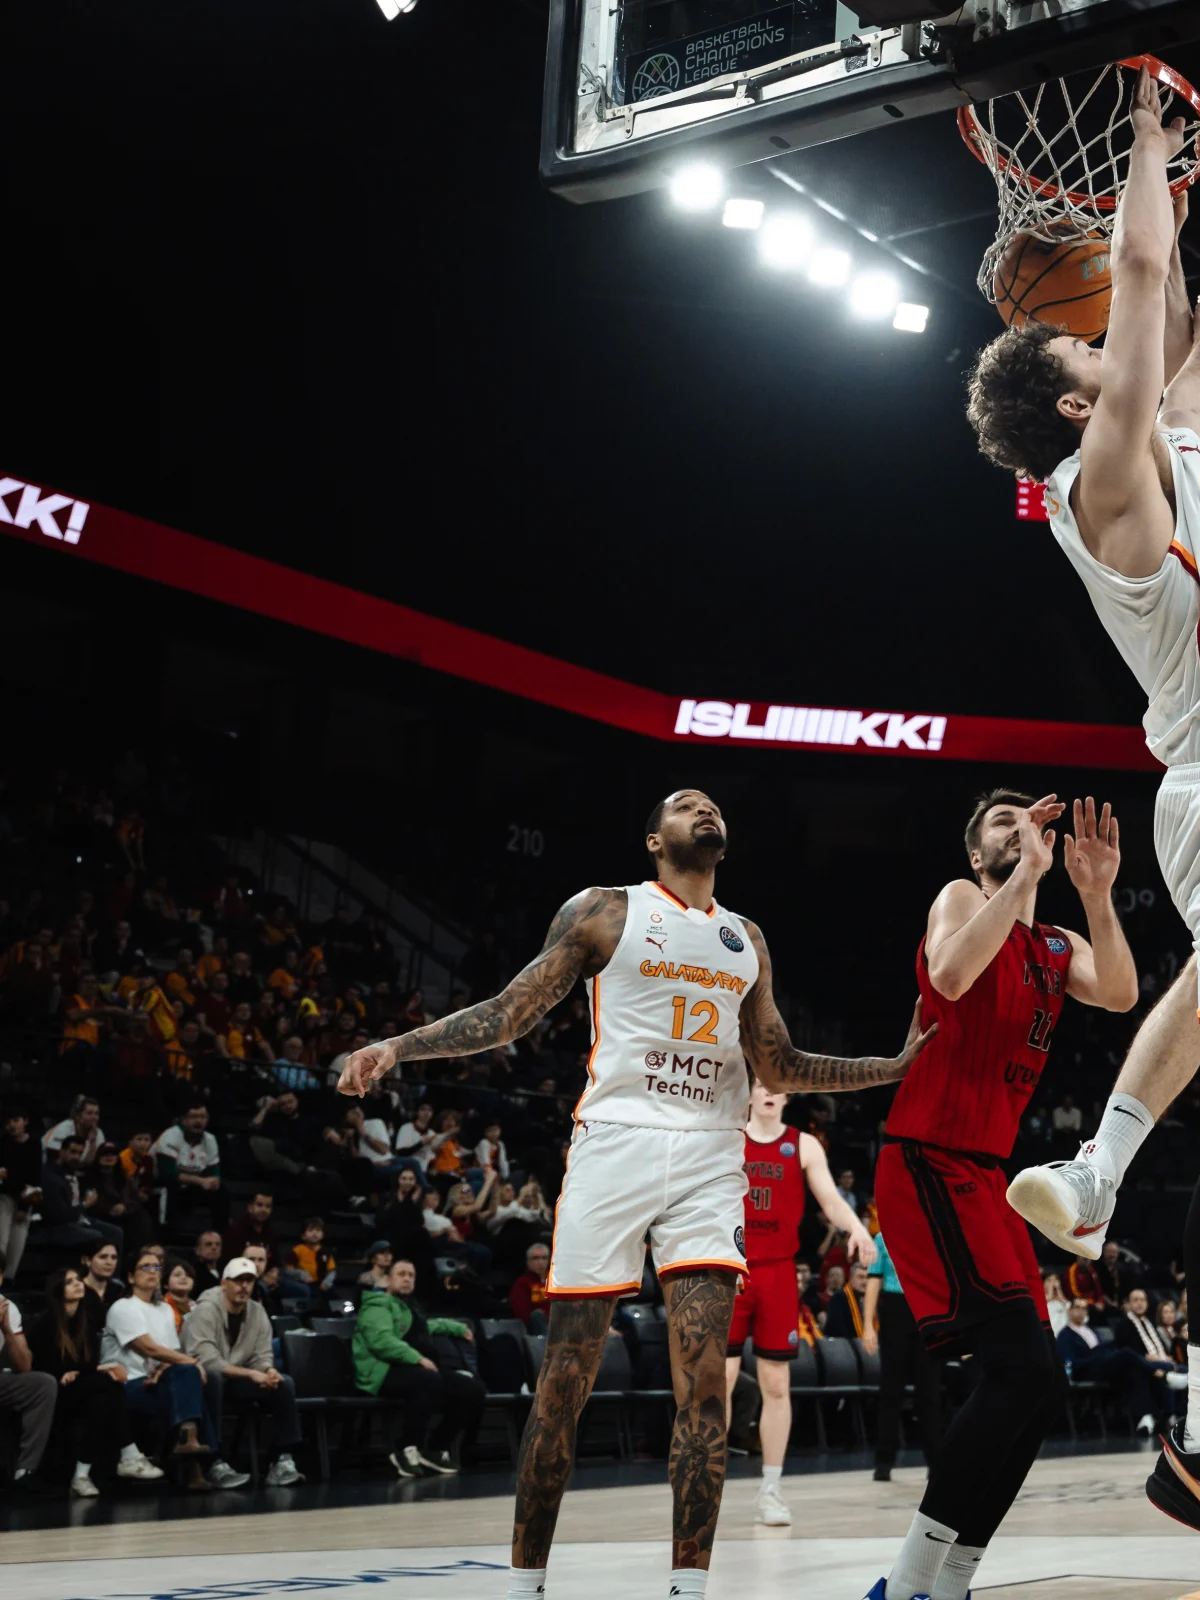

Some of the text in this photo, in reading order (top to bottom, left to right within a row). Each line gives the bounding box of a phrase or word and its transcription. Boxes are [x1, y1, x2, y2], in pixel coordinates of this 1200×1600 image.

[685, 28, 785, 70] CHAMPIONS
[686, 19, 774, 55] BASKETBALL
[684, 58, 738, 84] LEAGUE
[506, 823, 545, 858] 210
[640, 959, 748, 995] GALATASARAY
[671, 995, 719, 1045] 12
[671, 1053, 724, 1083] MCT
[749, 1186, 772, 1211] 41
